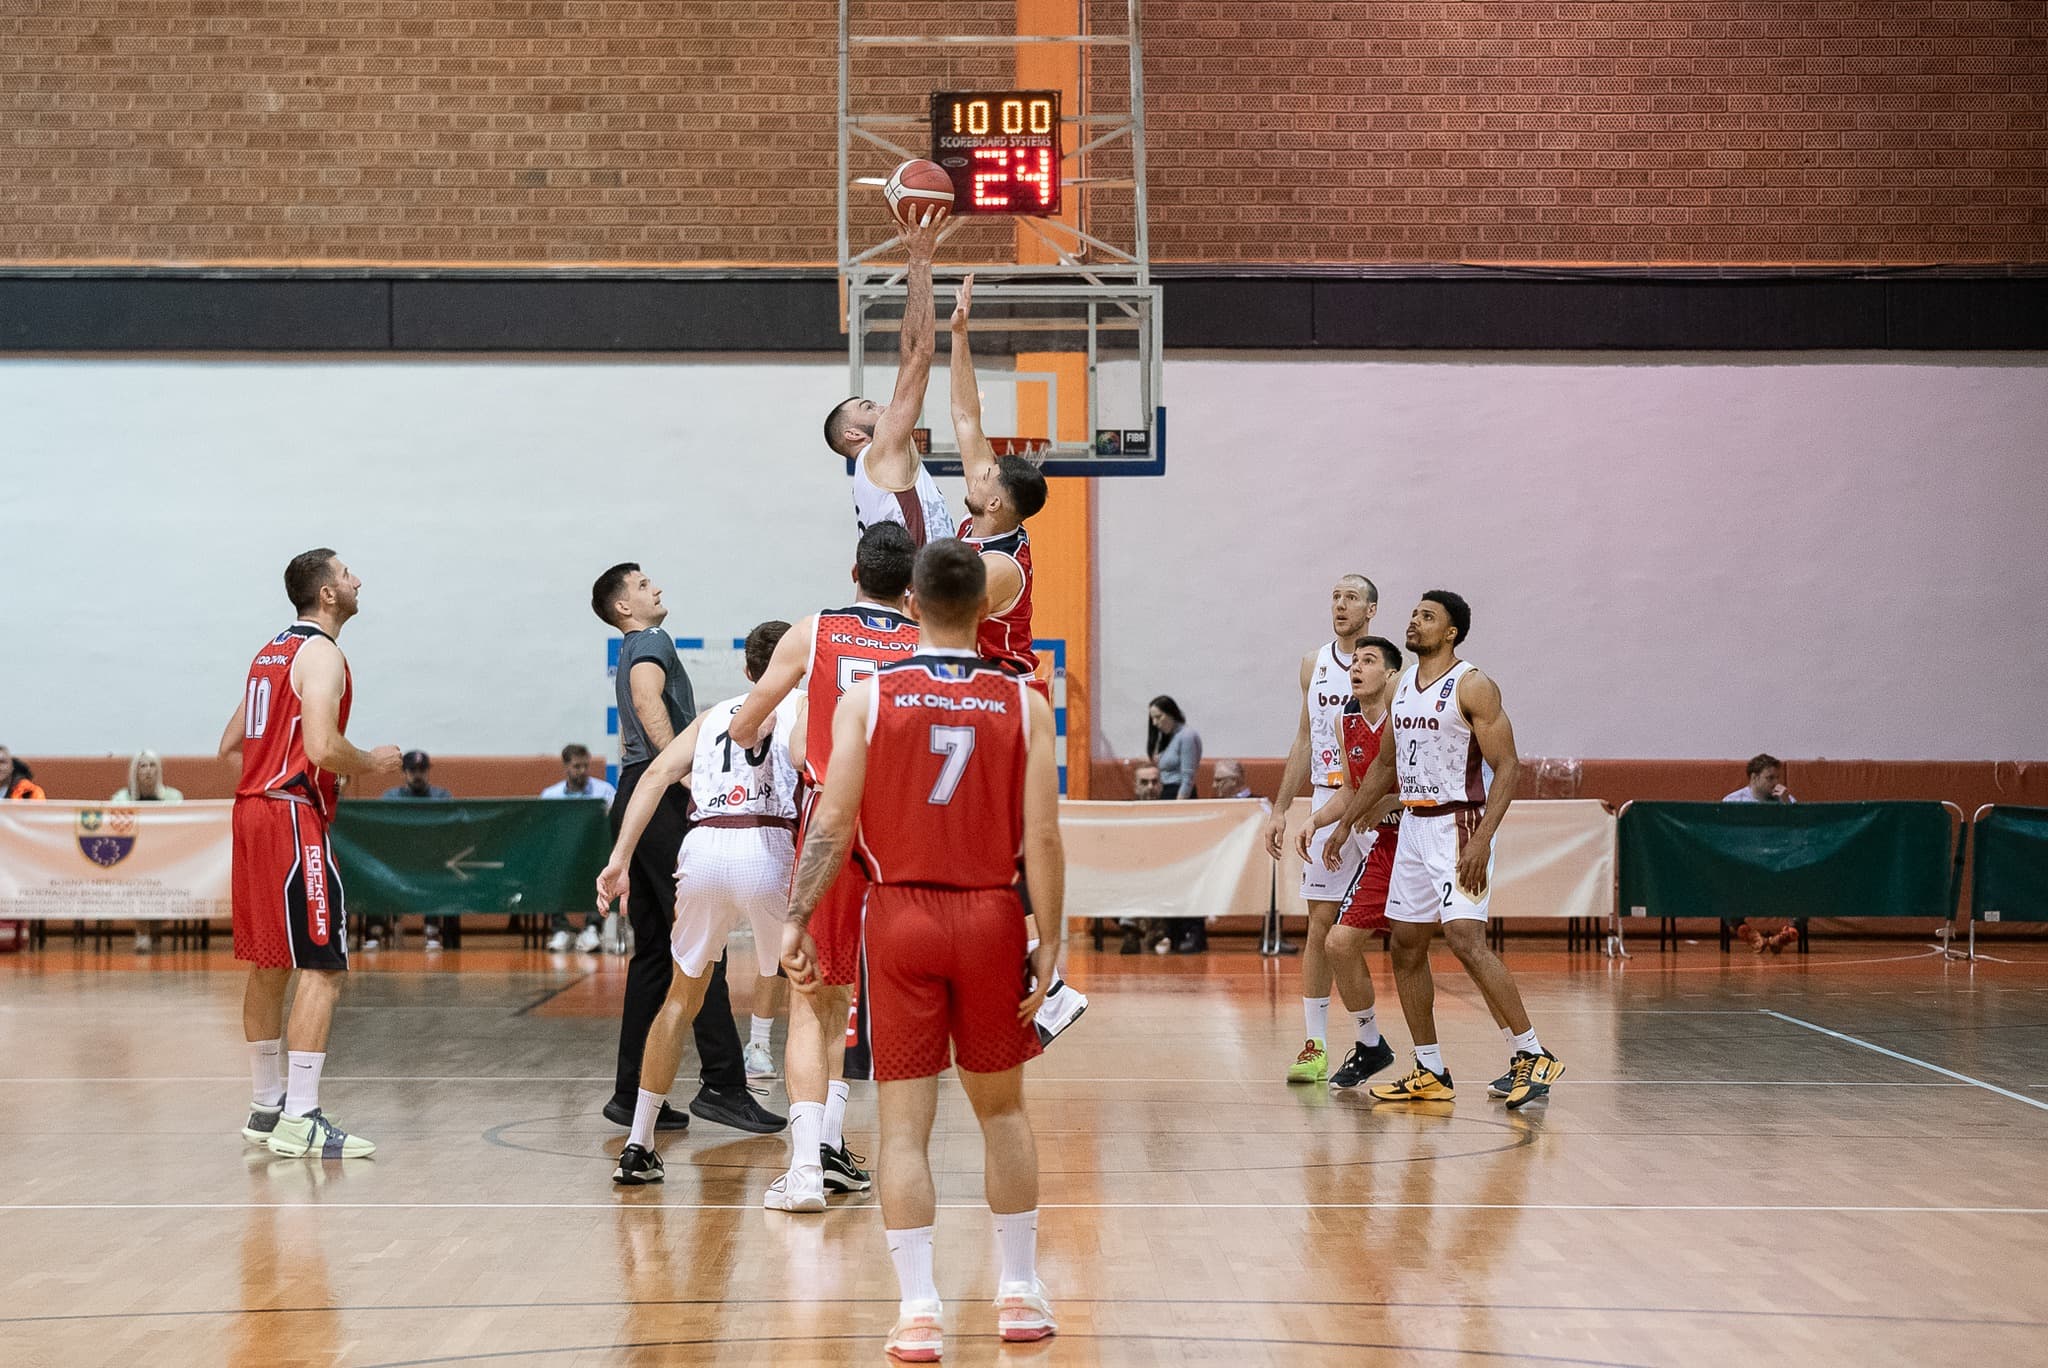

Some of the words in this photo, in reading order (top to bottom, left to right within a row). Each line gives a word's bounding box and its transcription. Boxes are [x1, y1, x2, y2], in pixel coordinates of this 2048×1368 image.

[940, 136, 1008, 148] SCOREBOARD
[1010, 135, 1051, 147] SYSTEMS
[975, 150, 1049, 205] 24
[1126, 432, 1146, 443] FIBA
[831, 633, 853, 644] KK
[855, 637, 919, 653] ORLOVI
[246, 677, 272, 738] 10
[894, 694, 921, 708] KK
[924, 694, 1007, 714] ORLOVIK
[1318, 692, 1350, 707] bos
[1394, 713, 1440, 731] bosna
[1408, 739, 1417, 766] 2
[928, 724, 976, 806] 7
[1403, 775, 1417, 784] VISIT
[1403, 784, 1440, 794] SARAJEVO
[309, 845, 326, 936] ROCKPUR
[1442, 881, 1454, 908] 2
